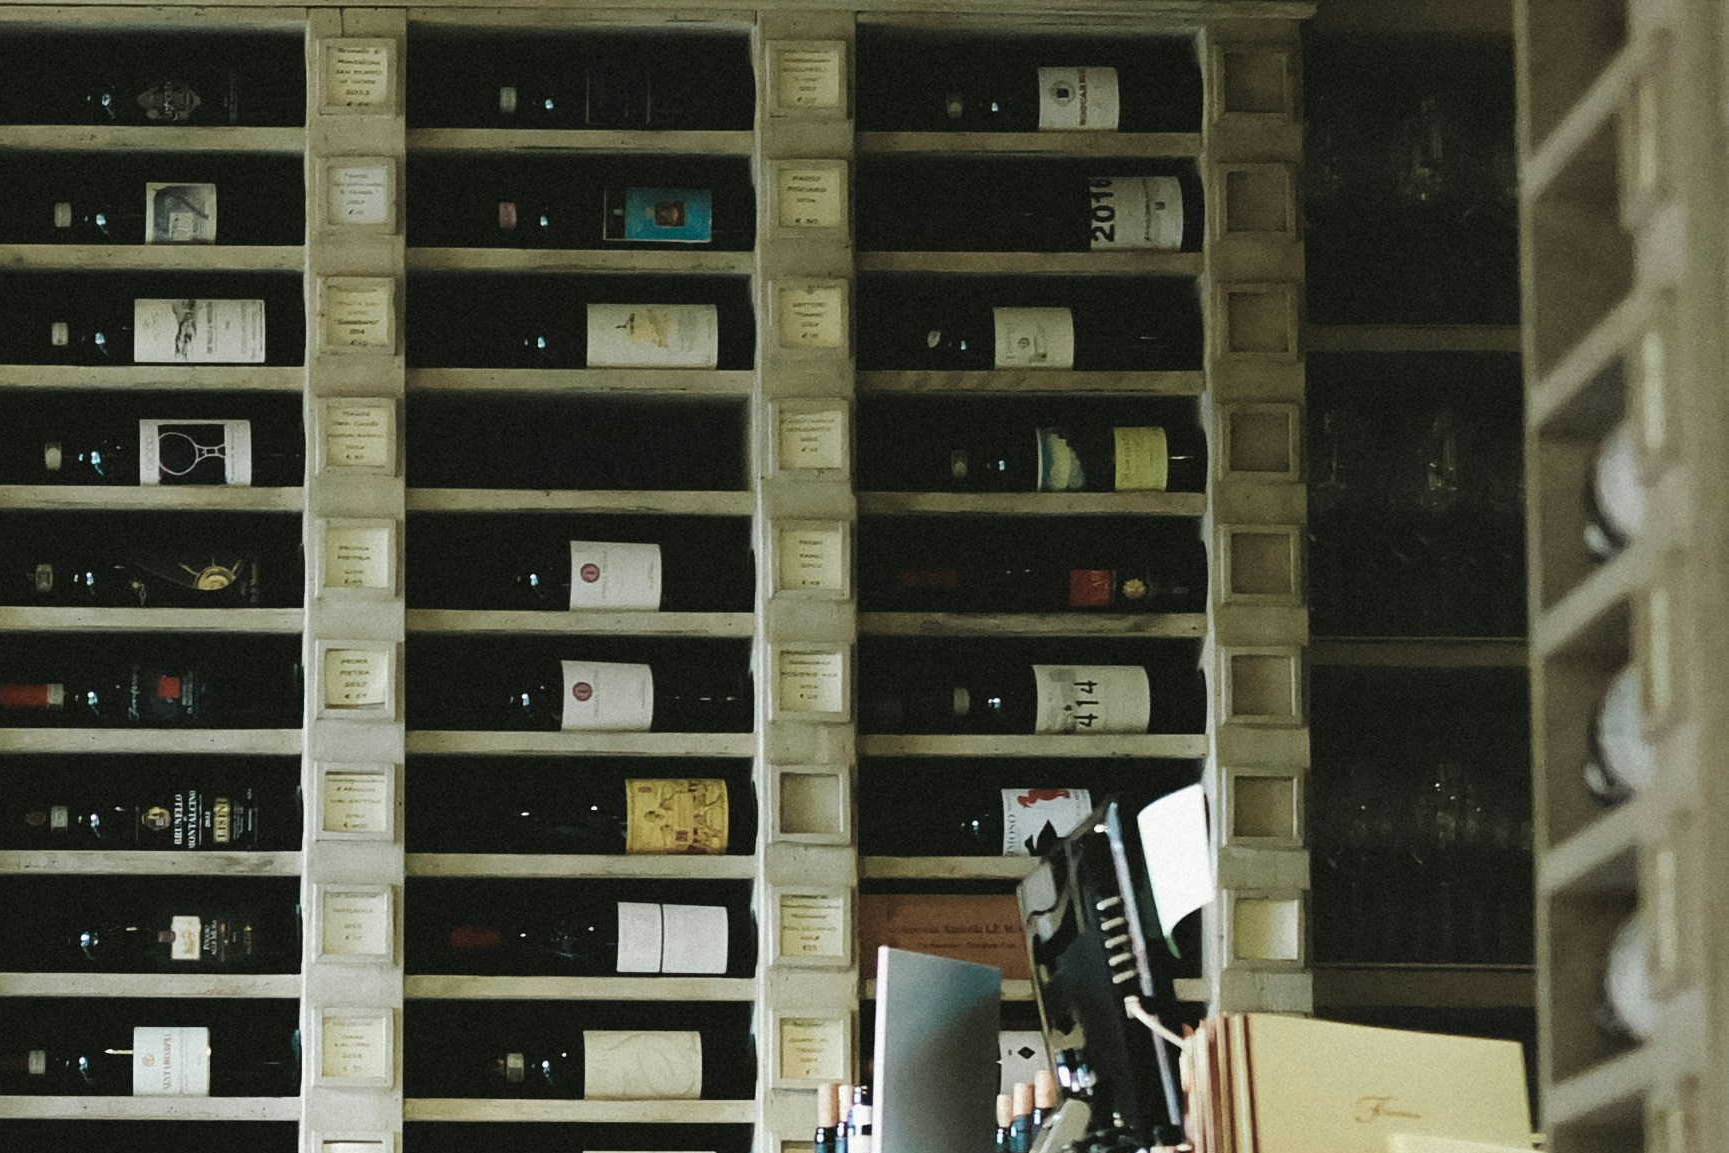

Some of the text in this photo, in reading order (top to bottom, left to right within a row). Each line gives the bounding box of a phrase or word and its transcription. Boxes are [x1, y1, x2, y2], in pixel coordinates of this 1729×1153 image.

[1074, 680, 1098, 727] 414
[174, 793, 183, 845] BRUNELLO
[188, 790, 197, 848] MONTALCINO
